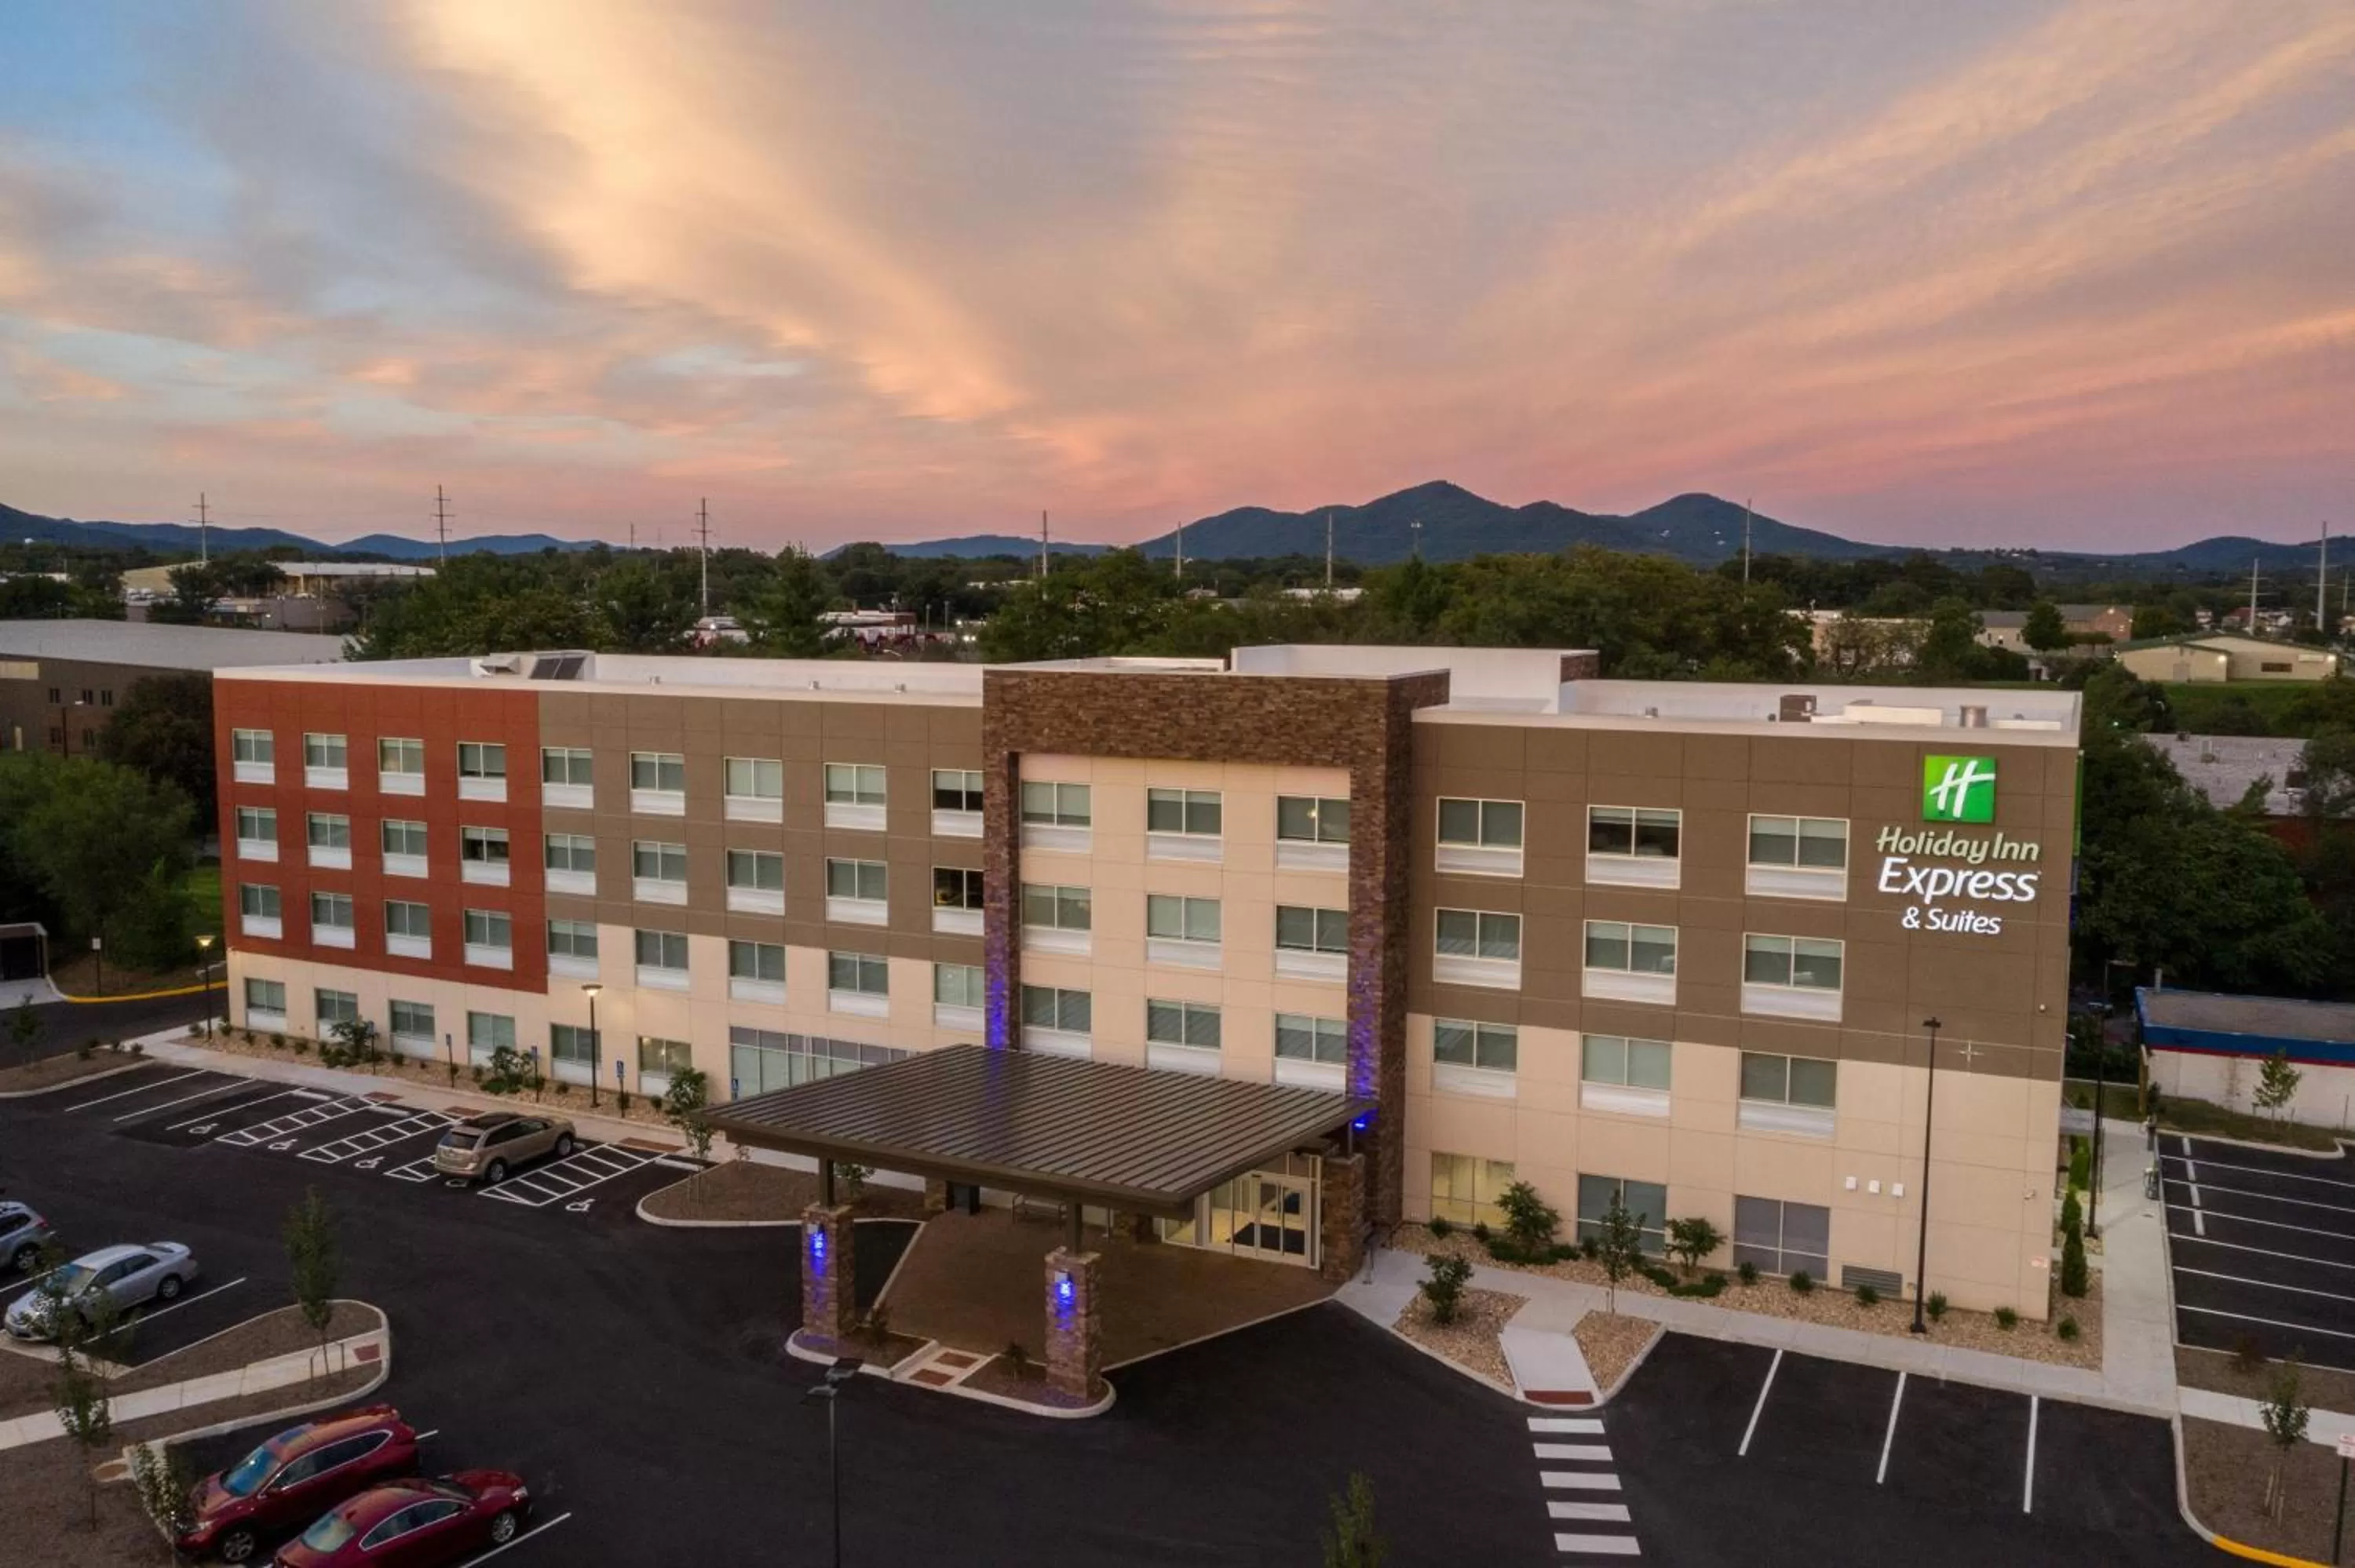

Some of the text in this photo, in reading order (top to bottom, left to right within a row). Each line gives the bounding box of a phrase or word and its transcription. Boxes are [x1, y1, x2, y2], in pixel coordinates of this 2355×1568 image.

[1930, 760, 1996, 818] H
[1876, 826, 2040, 864] Holiday Inn
[1879, 856, 2038, 905] Express
[1902, 906, 2002, 935] & Suites
